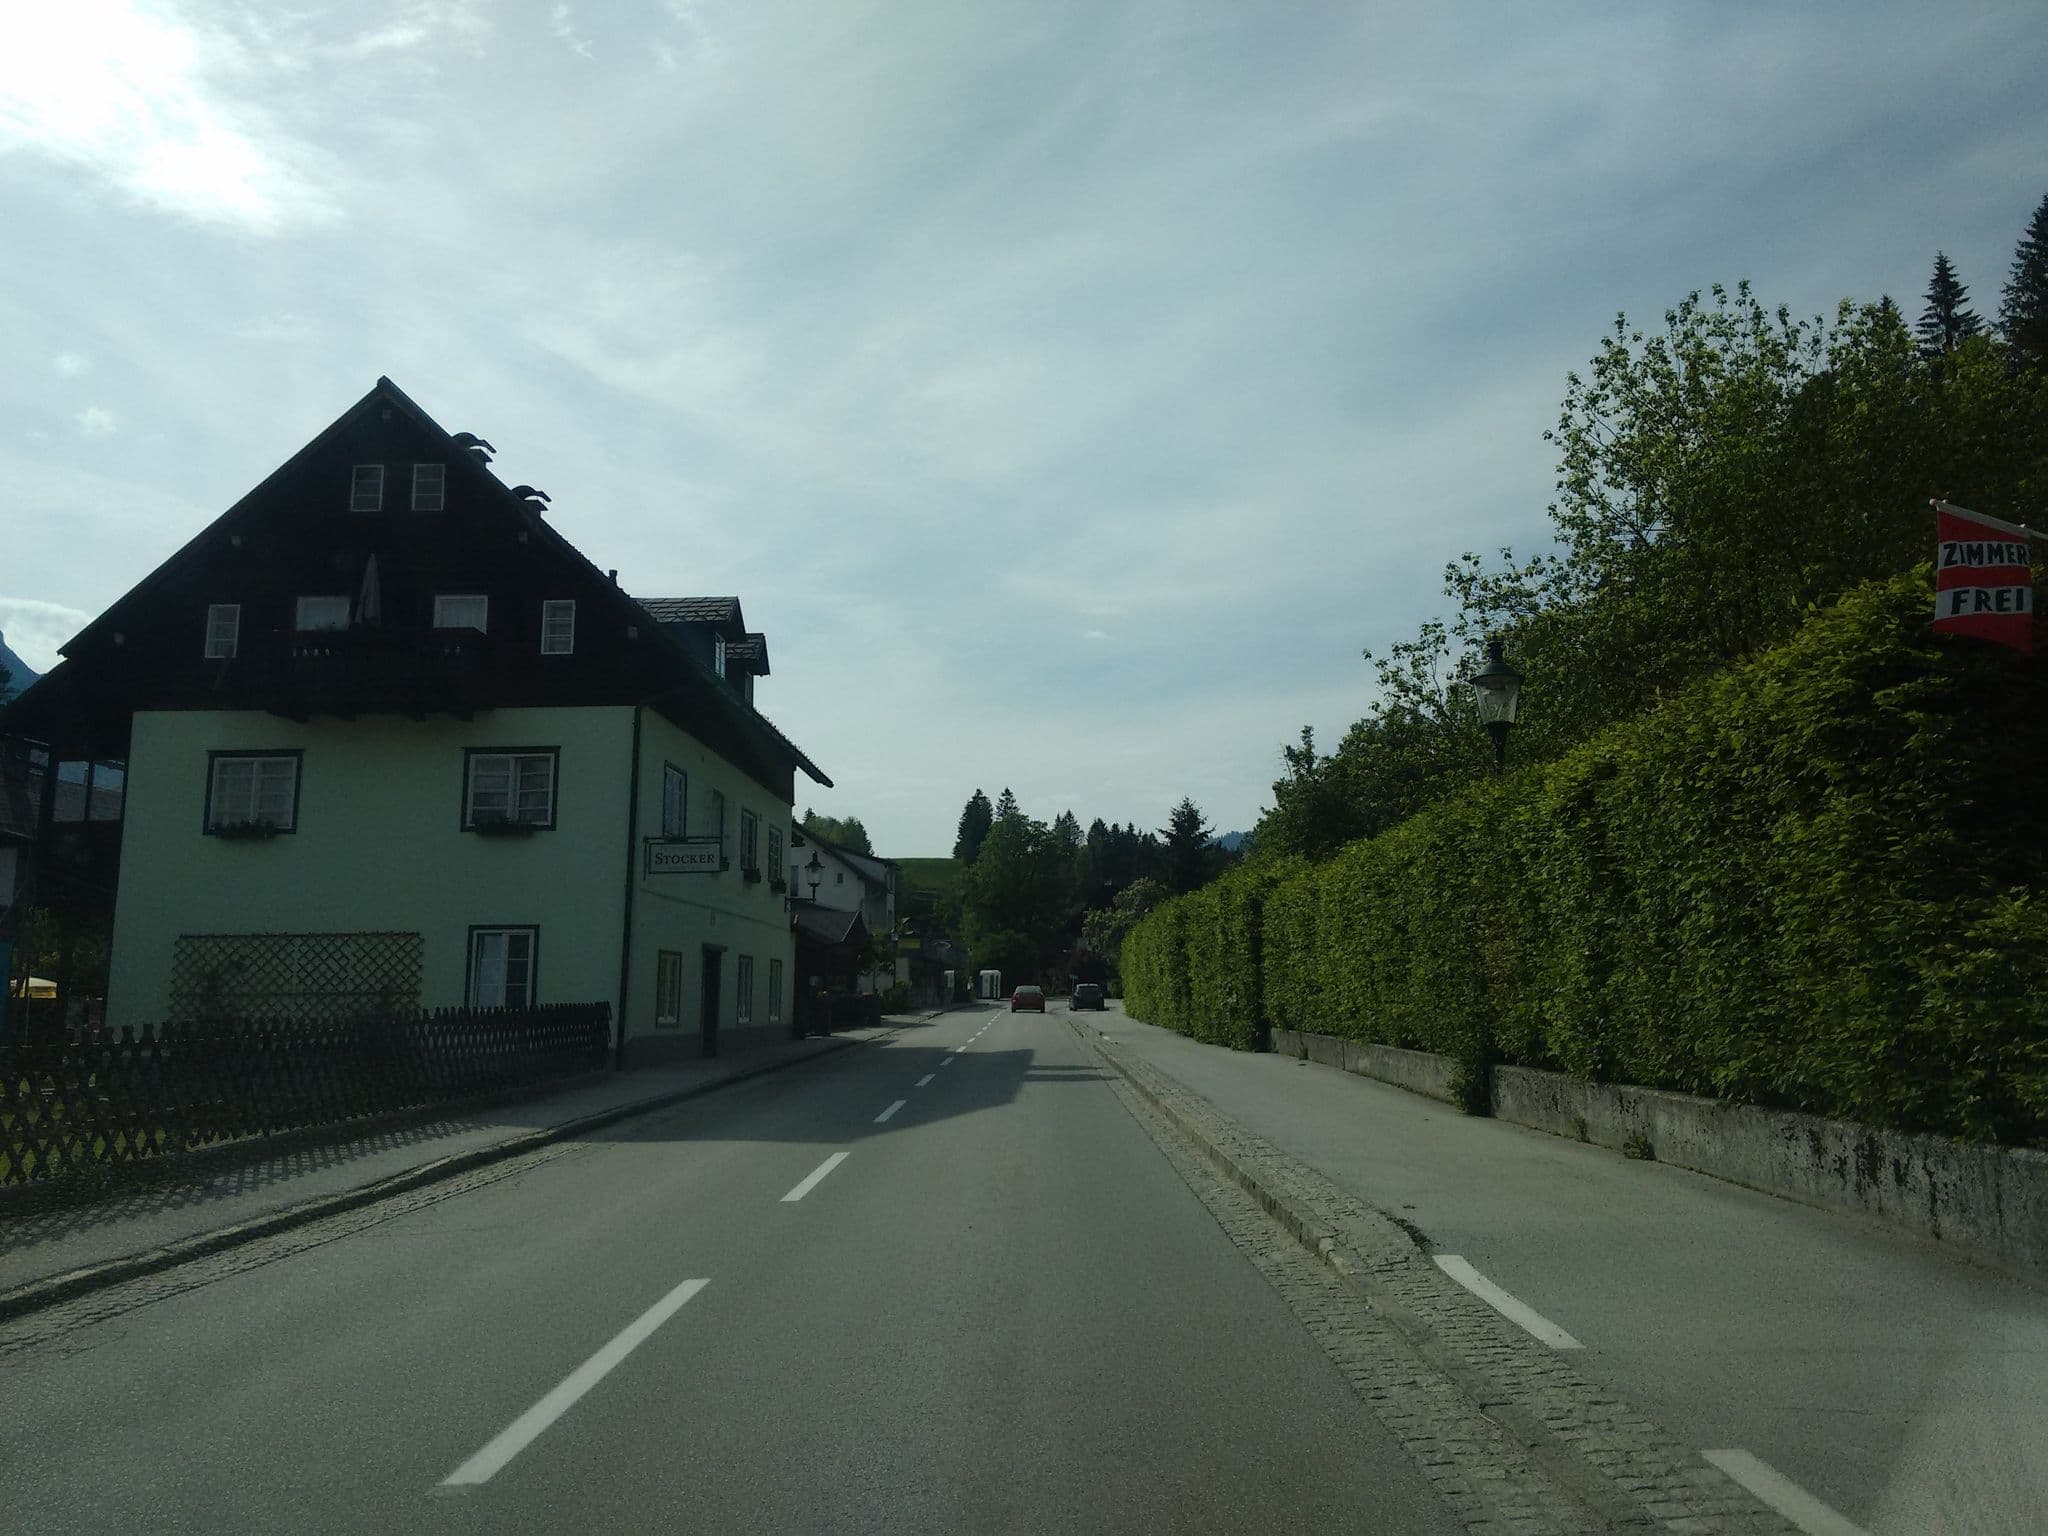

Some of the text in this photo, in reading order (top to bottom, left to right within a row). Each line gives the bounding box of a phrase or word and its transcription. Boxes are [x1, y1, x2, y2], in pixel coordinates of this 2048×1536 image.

[1943, 542, 2028, 567] ZIMMER
[1951, 588, 2024, 615] FREI
[655, 851, 714, 865] STOCKER
